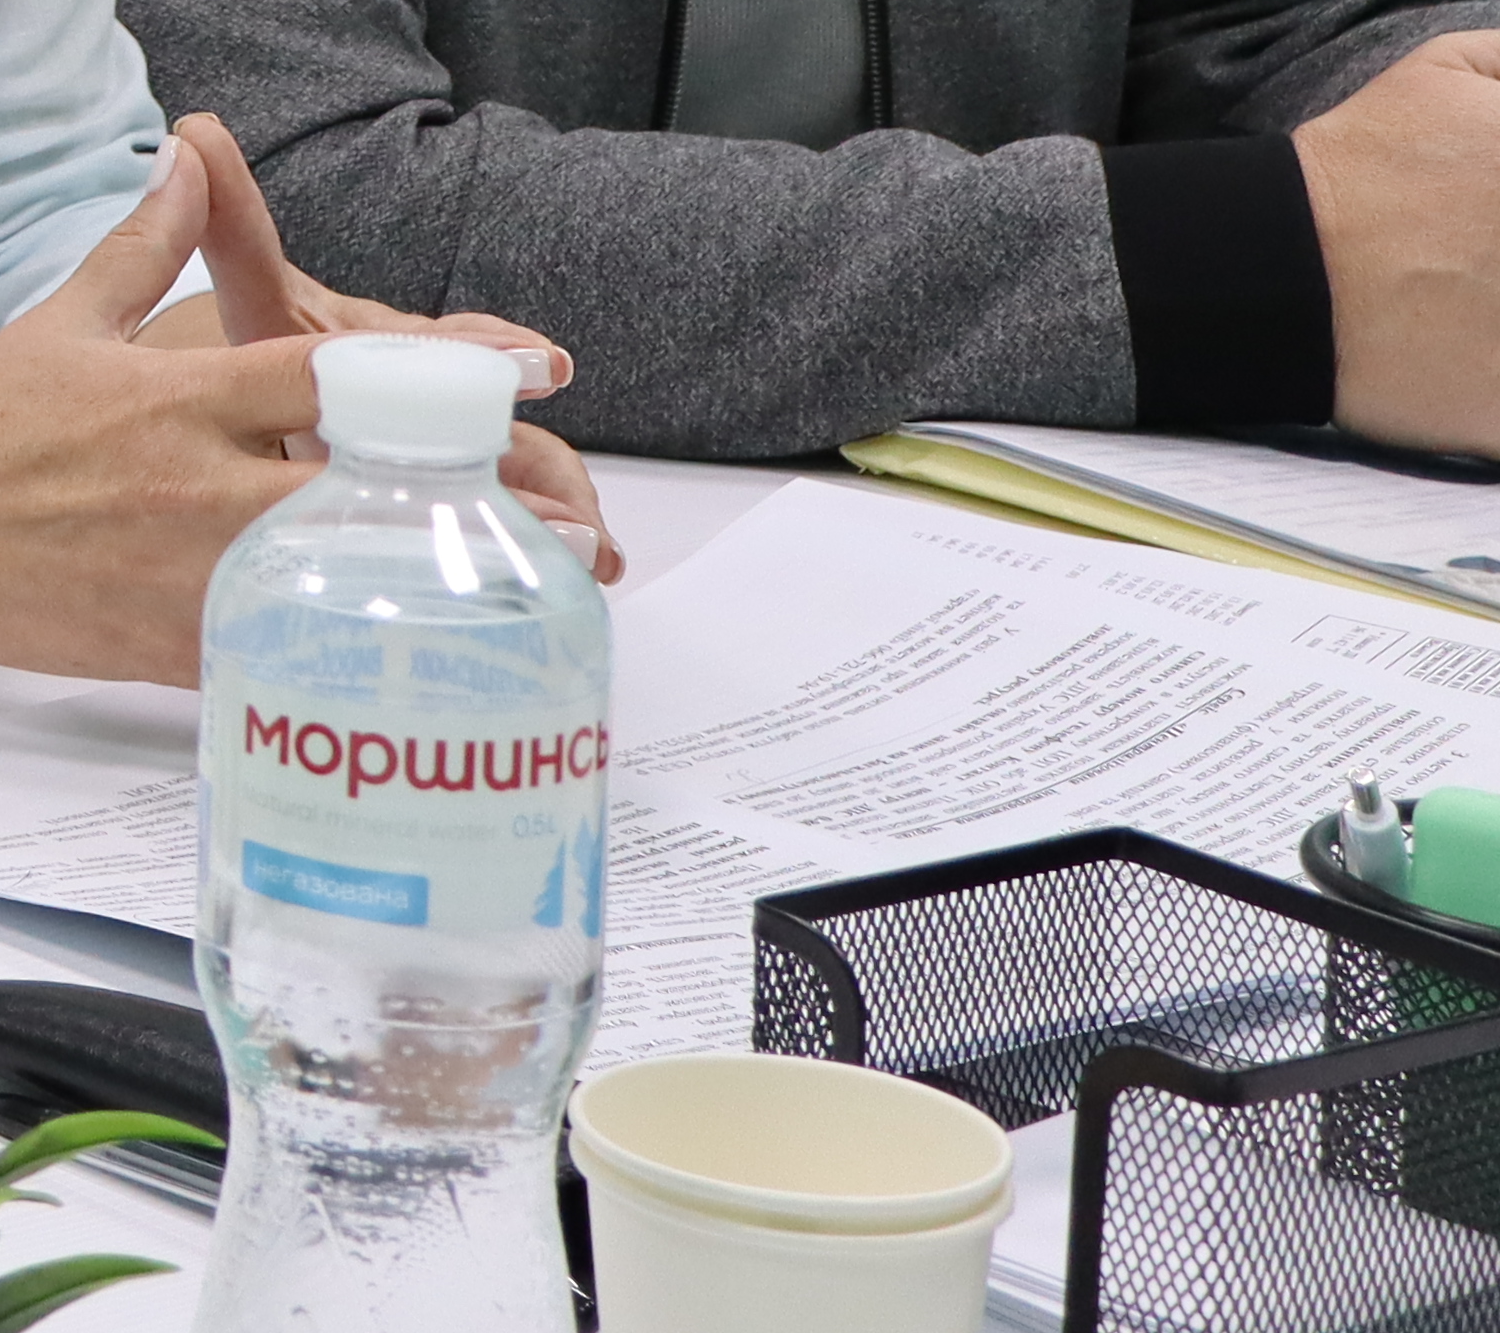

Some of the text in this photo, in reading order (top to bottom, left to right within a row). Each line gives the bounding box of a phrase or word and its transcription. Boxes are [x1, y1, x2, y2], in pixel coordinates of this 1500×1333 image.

[993, 703, 1056, 732] України
[1091, 686, 1146, 717] номеру
[1193, 688, 1246, 715] Сервіс
[1020, 720, 1090, 753] телефону
[1069, 699, 1158, 748] конкретному
[1098, 712, 1171, 753] платникам
[1167, 721, 1260, 774] (фінансових)
[1190, 738, 1263, 782] реквізитах
[1277, 740, 1336, 773] частину
[1185, 773, 1285, 822] Електронного
[1197, 827, 1255, 851] запрова
[252, 855, 411, 912] негазована
